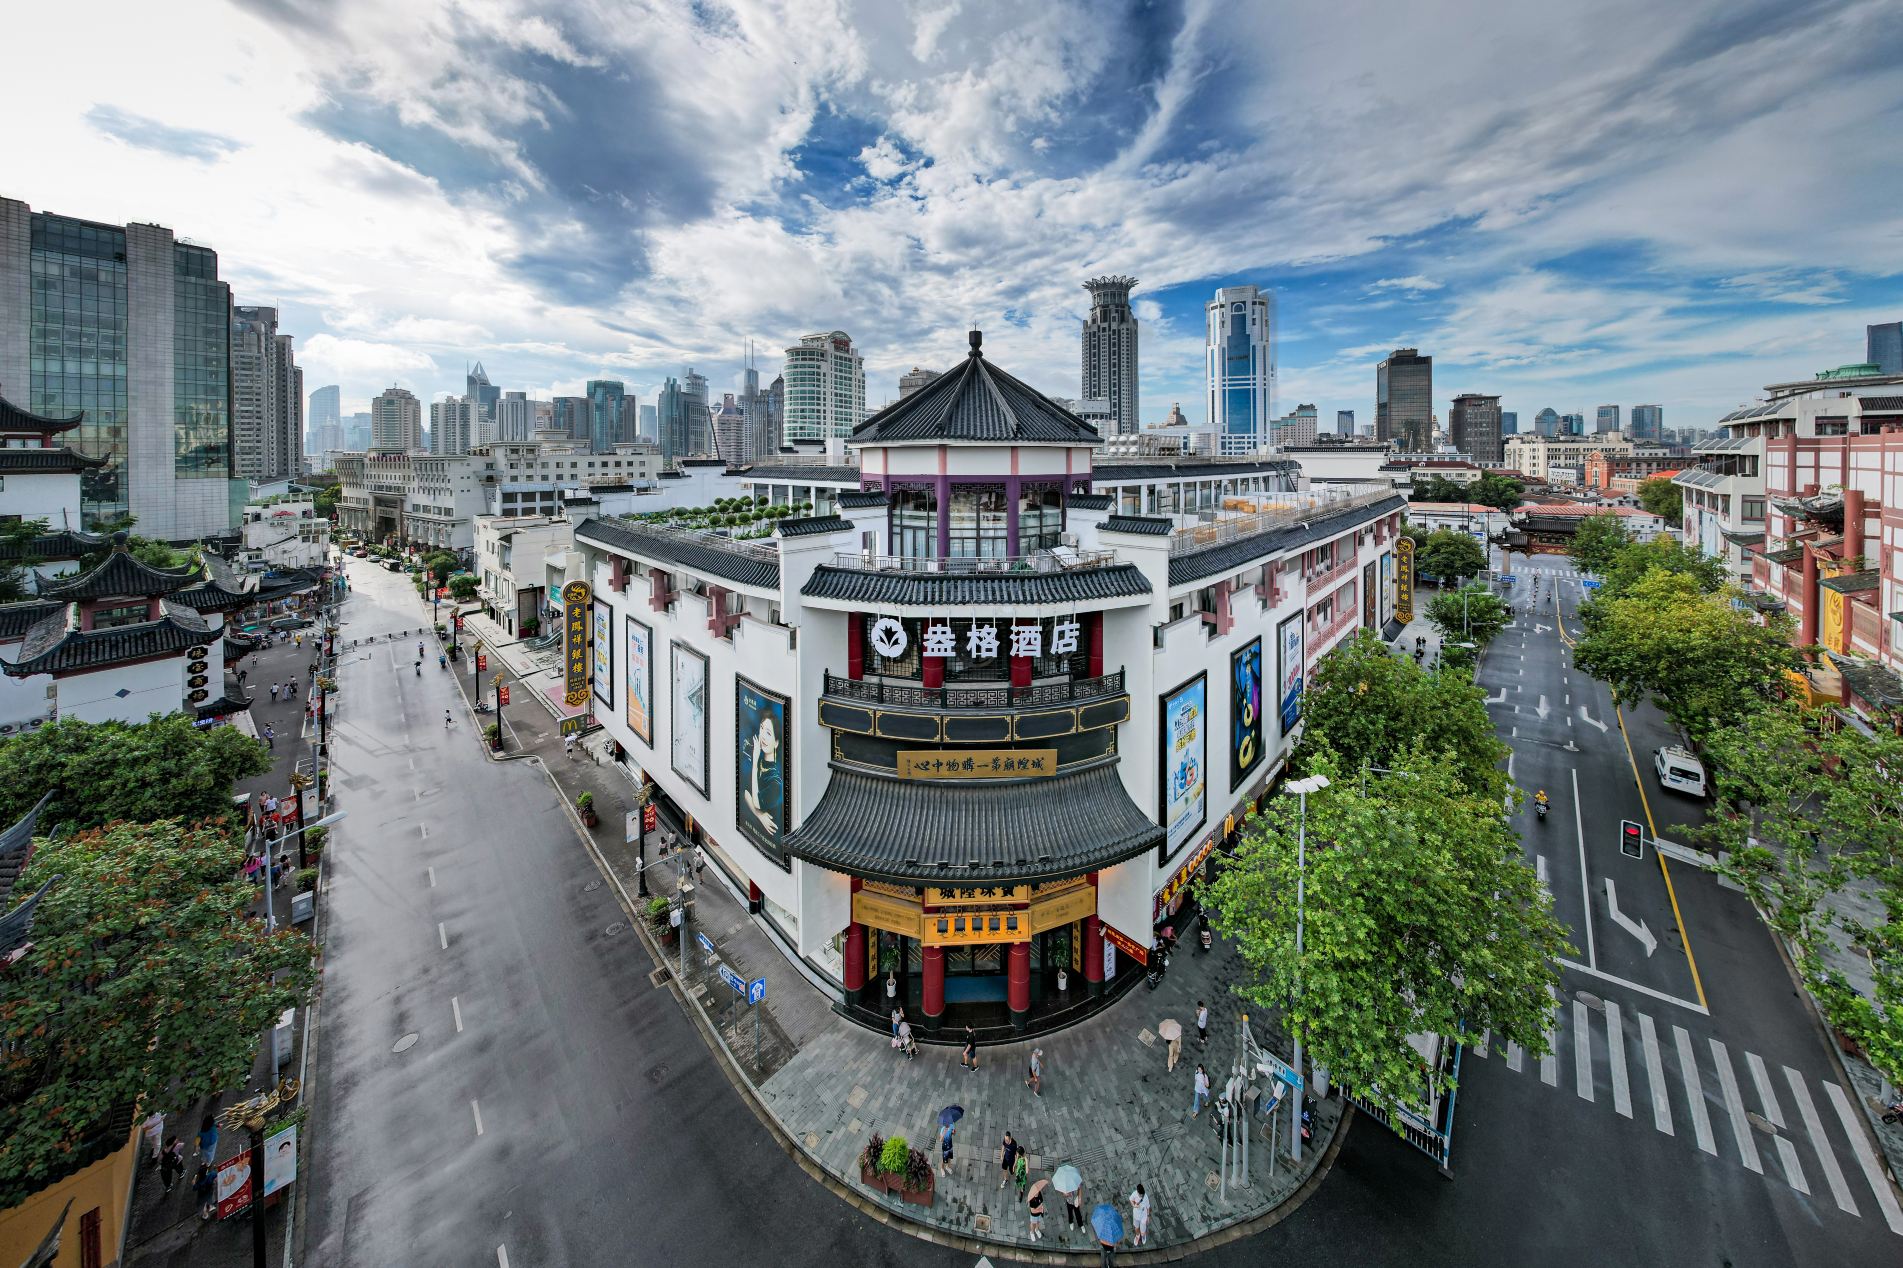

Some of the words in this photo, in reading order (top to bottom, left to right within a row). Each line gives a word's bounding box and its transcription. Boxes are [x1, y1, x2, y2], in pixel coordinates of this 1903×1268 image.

[571, 607, 584, 673] 老鳳祥銀樓
[923, 621, 1080, 658] 盎格酒店
